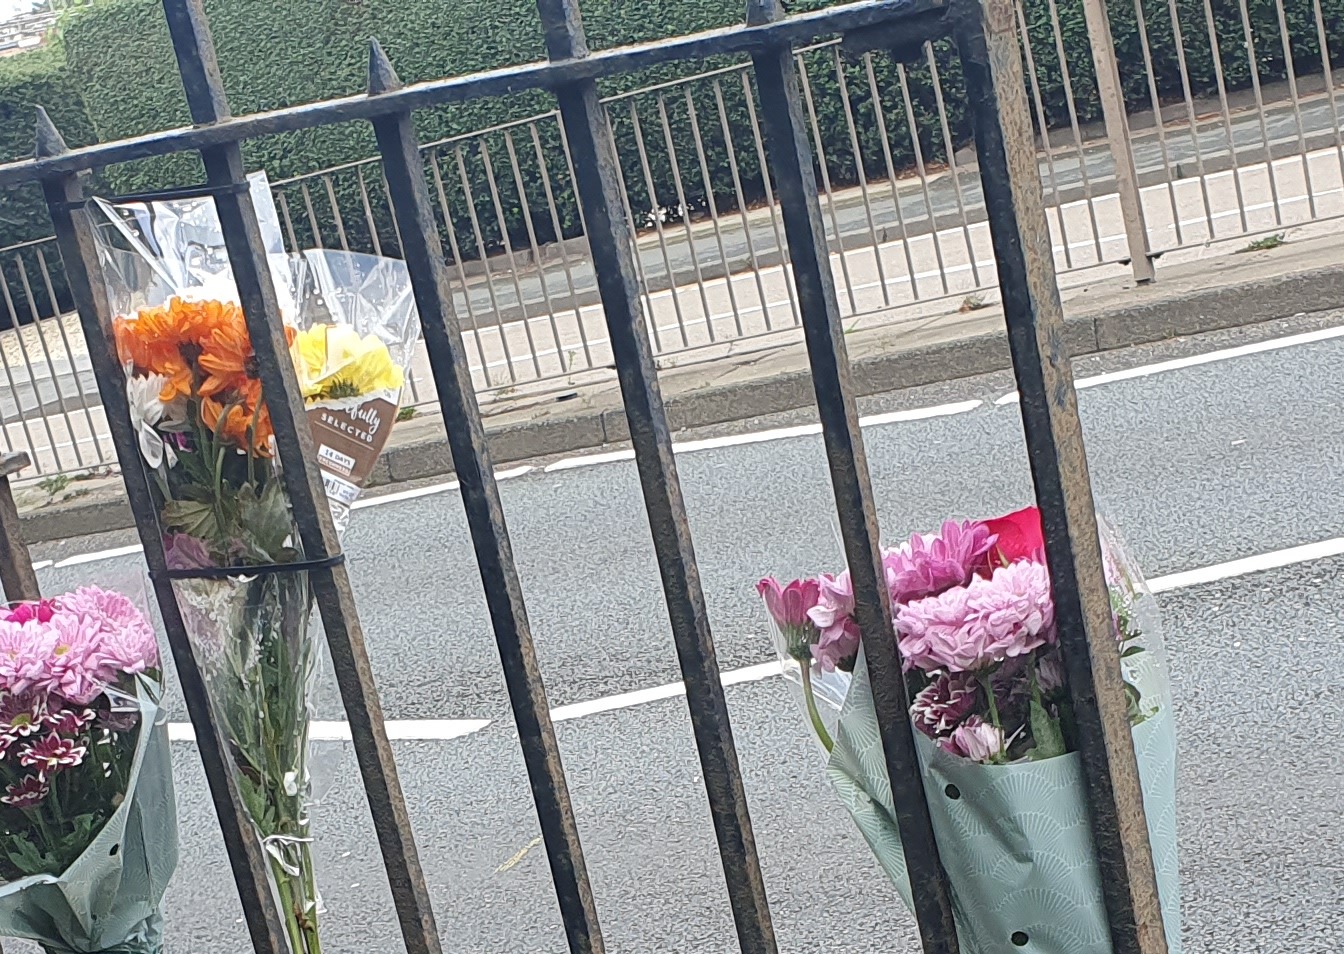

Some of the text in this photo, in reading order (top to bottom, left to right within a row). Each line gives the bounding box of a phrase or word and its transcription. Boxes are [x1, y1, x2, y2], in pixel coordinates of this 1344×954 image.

[321, 413, 373, 443] SELECTED
[345, 404, 380, 434] efully
[325, 449, 351, 466] 14 DAYS
